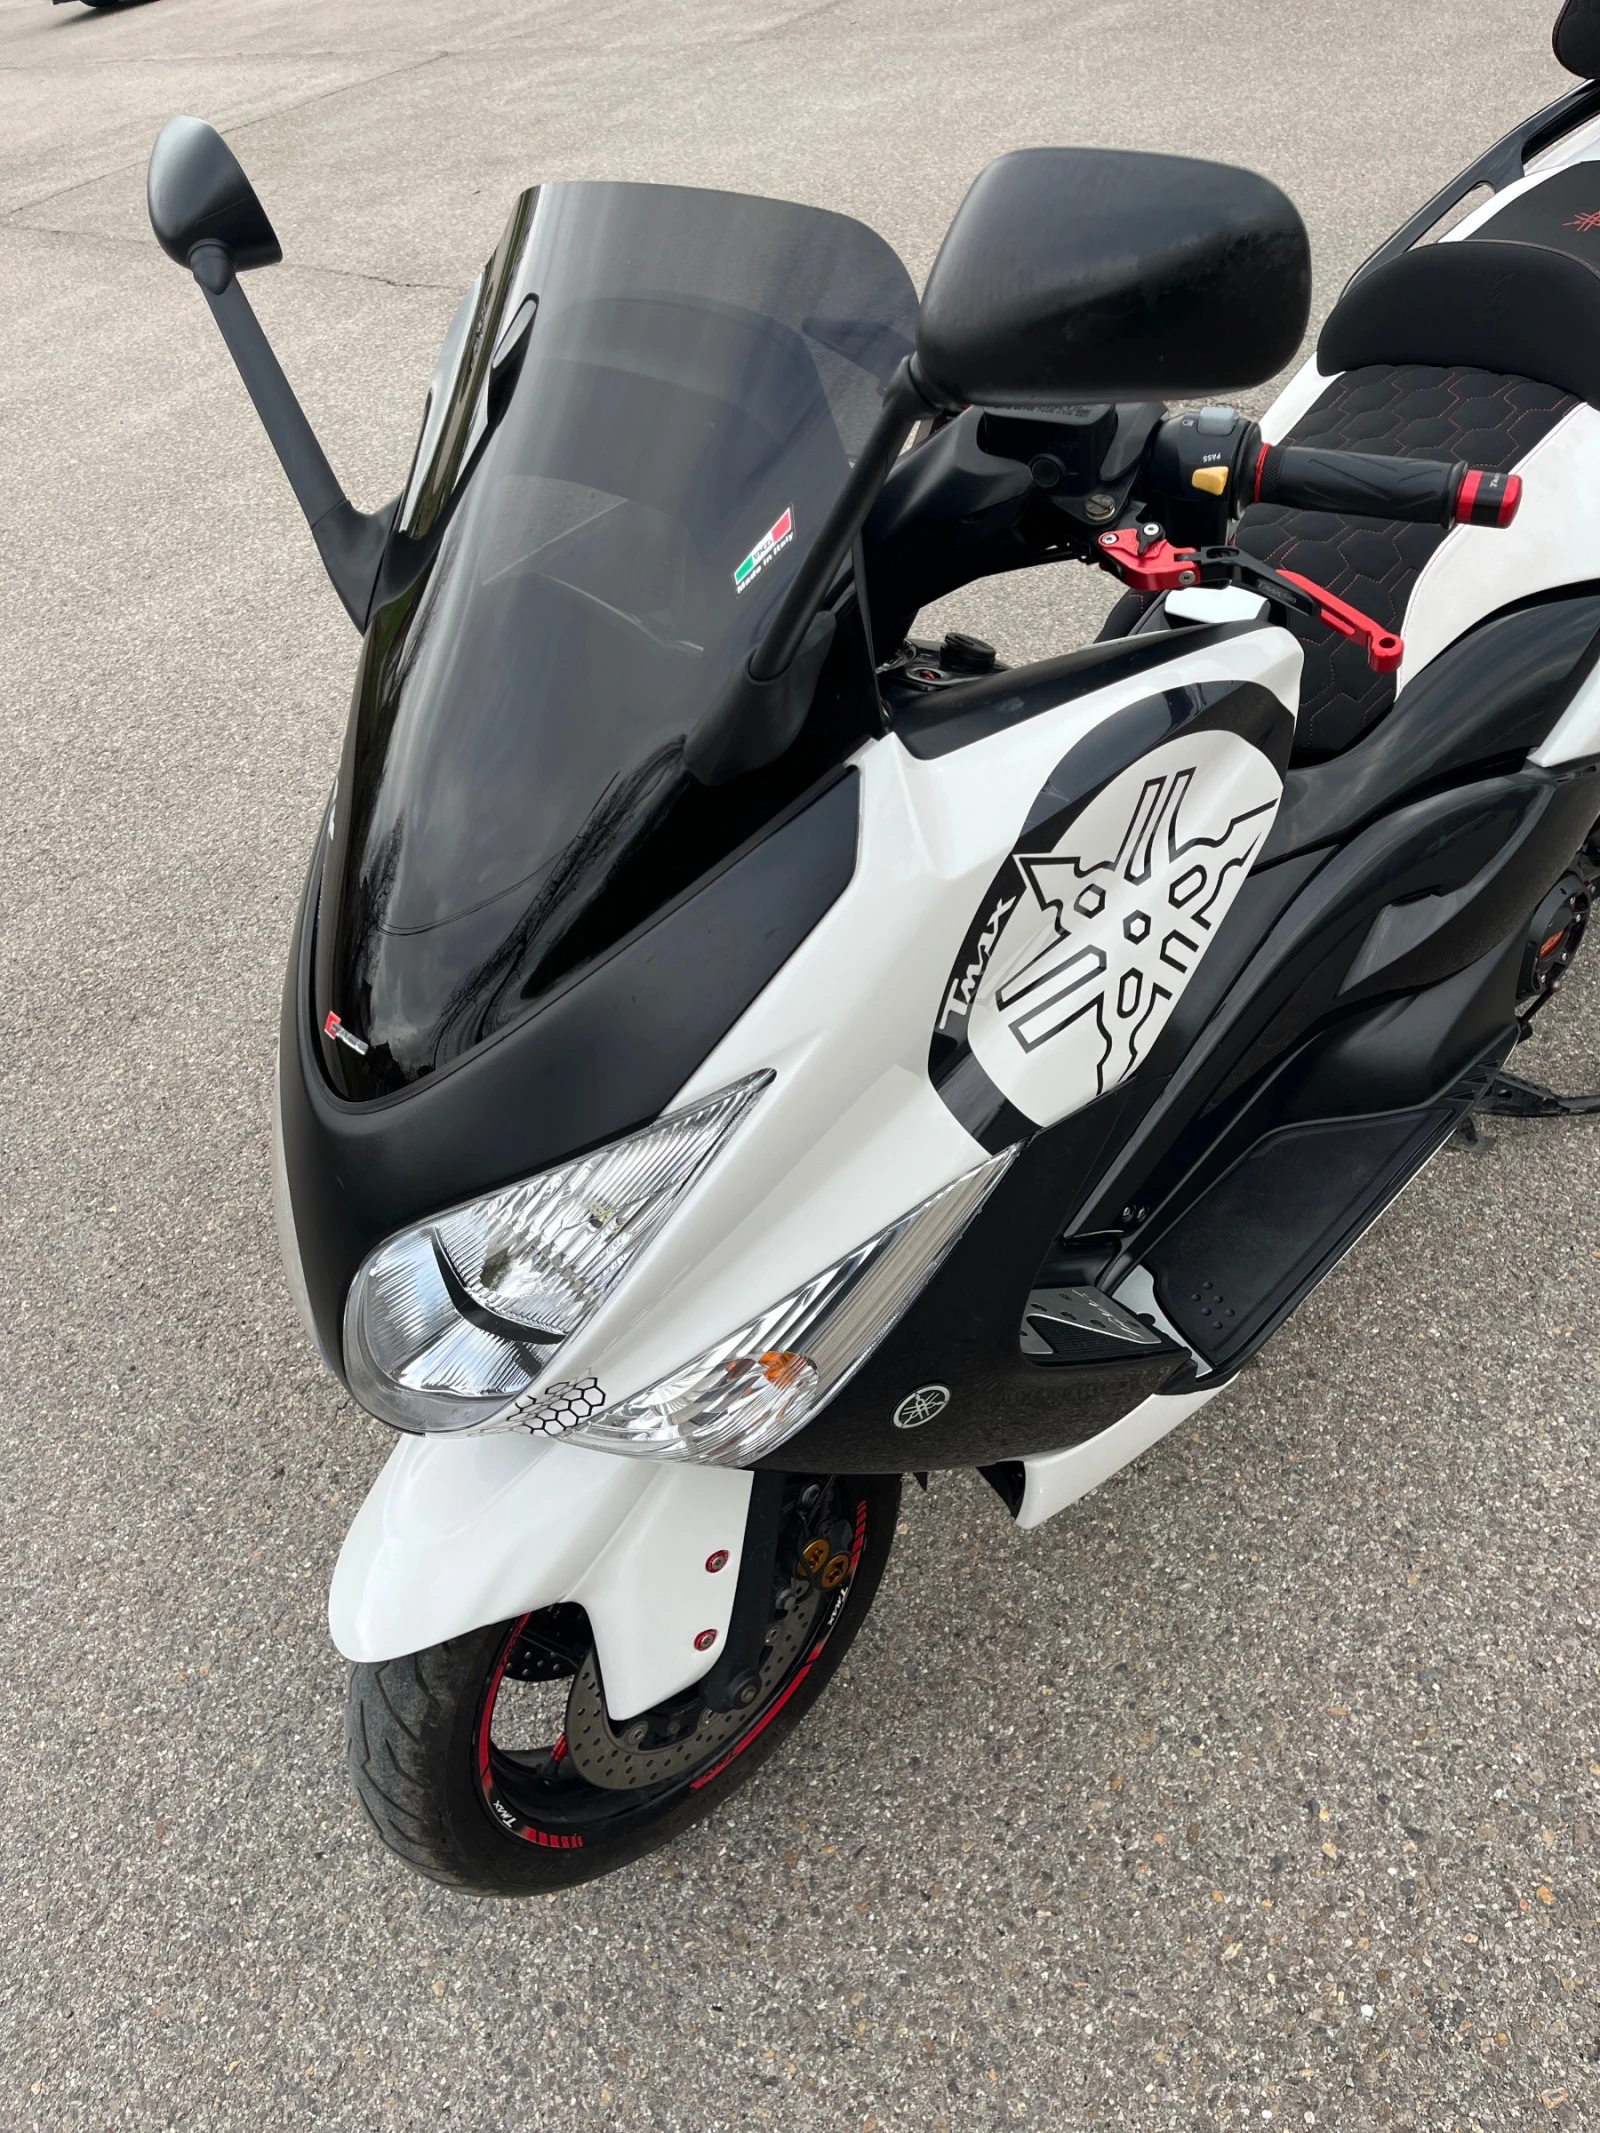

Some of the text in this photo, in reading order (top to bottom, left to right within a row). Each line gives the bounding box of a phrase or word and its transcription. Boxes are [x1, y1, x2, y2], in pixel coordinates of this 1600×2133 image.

[1202, 452, 1222, 463] PASS
[737, 565, 762, 594] Made
[773, 531, 794, 556] Italy
[939, 895, 1017, 1029] TMAX
[827, 1586, 849, 1626] TMAX
[493, 1799, 517, 1828] TMAX
